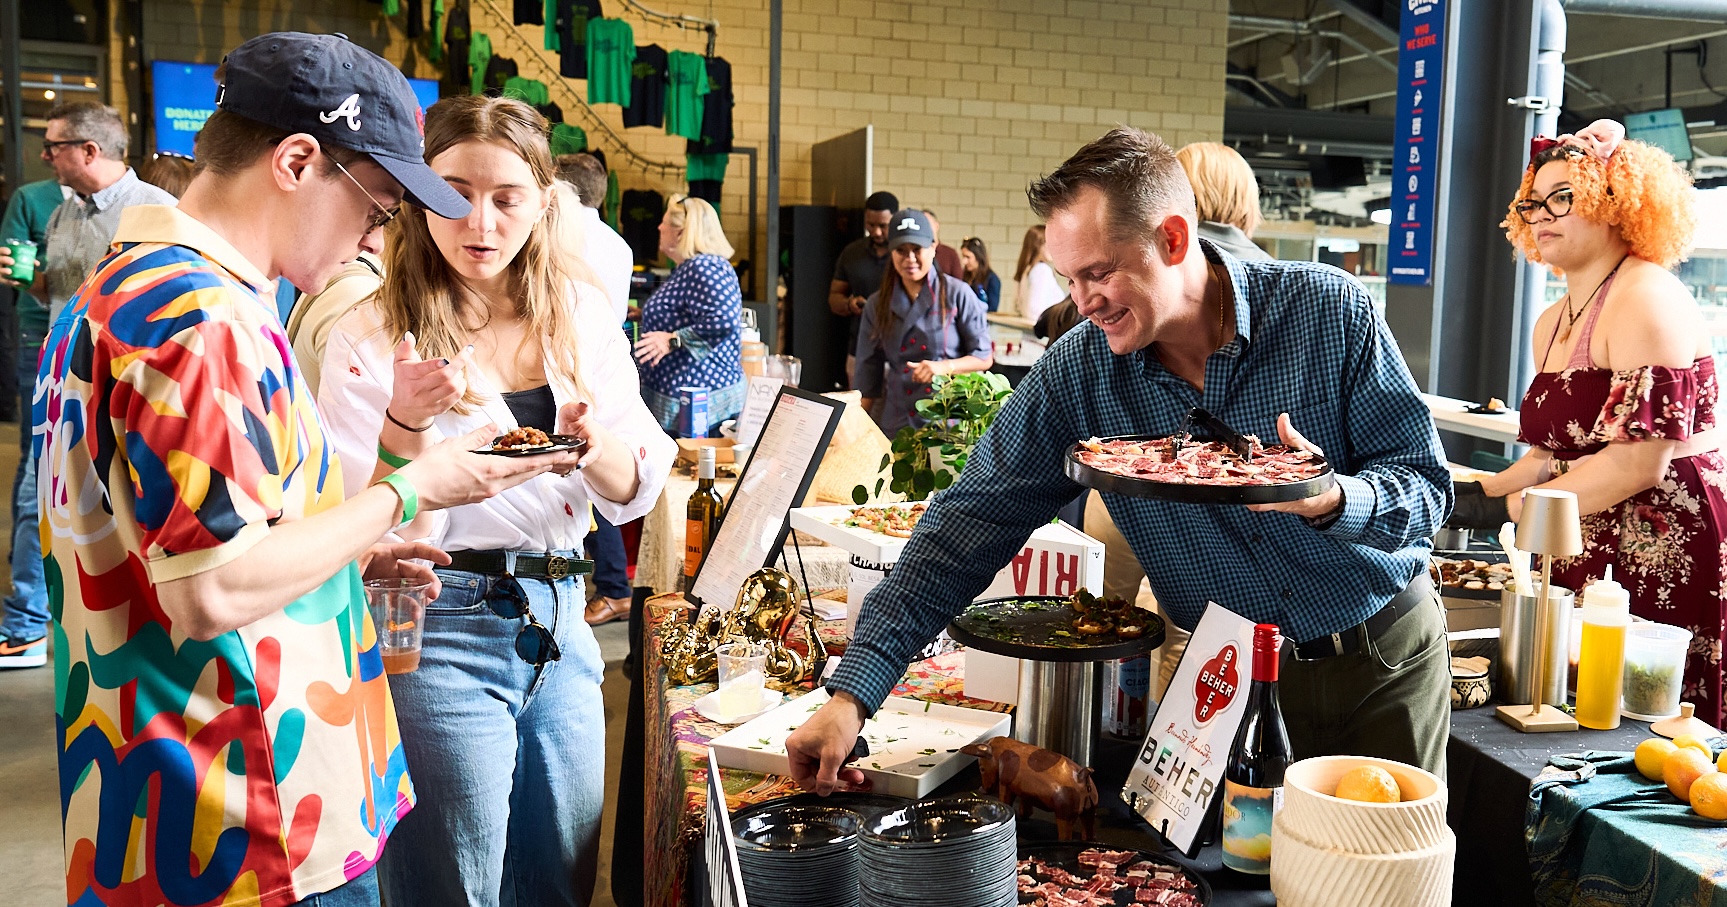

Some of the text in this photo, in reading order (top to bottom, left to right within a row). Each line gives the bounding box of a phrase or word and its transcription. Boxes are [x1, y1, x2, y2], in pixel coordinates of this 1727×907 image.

[319, 93, 361, 132] A
[1200, 670, 1235, 698] BEHER
[1139, 736, 1214, 809] BEHER
[1142, 775, 1190, 816] AUTÉNTICO
